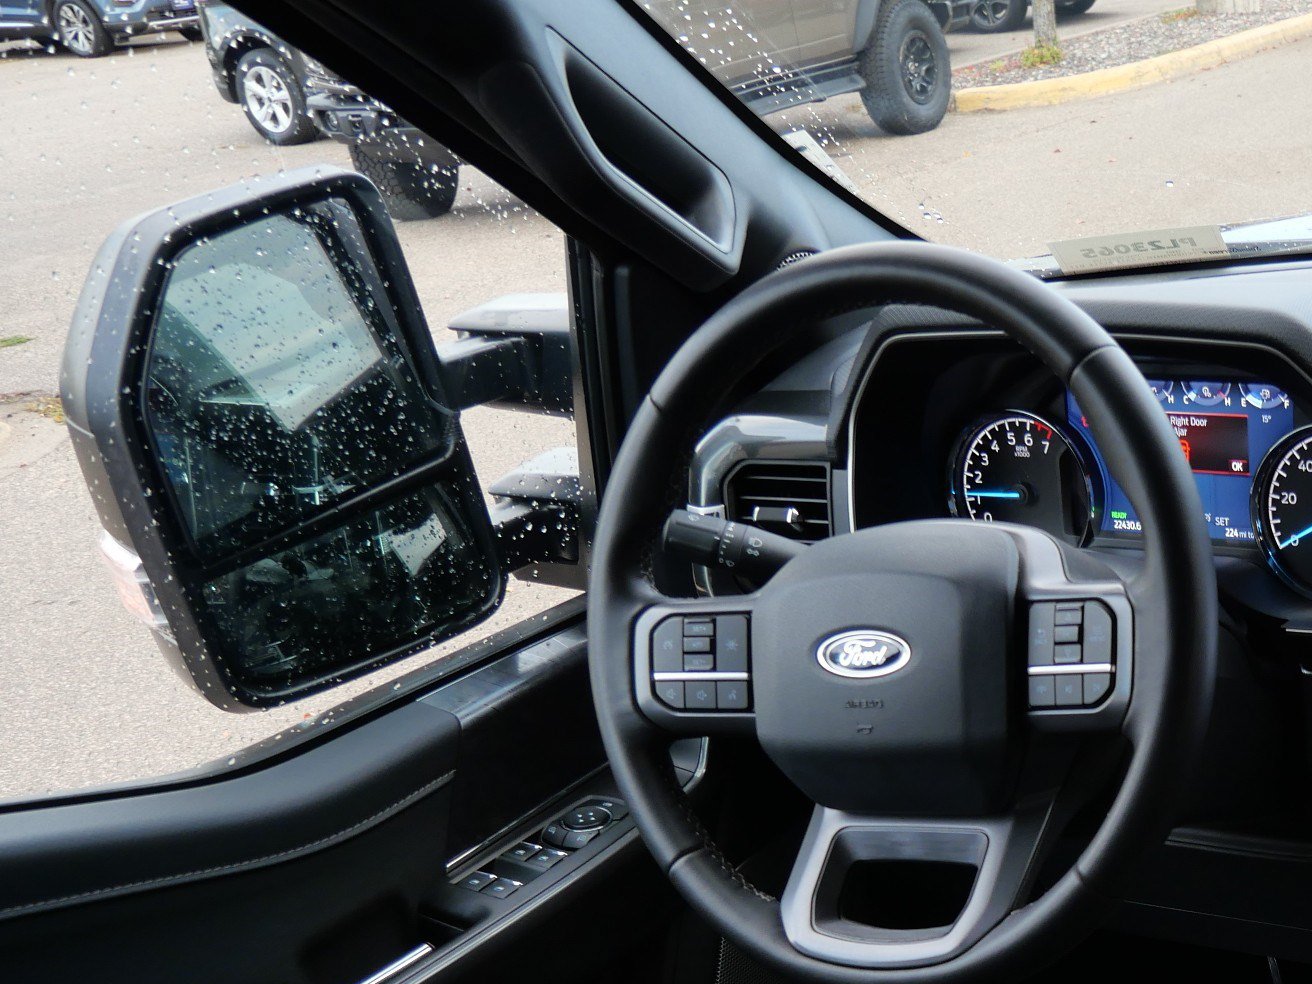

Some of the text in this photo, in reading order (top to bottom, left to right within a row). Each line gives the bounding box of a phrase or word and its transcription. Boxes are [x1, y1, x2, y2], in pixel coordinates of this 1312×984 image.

[1170, 416, 1207, 427] Right Door
[1007, 433, 1016, 446] 5
[1024, 433, 1033, 446] 6
[991, 440, 1000, 453] 4
[1041, 441, 1050, 455] 7
[981, 453, 989, 466] 3
[1231, 462, 1243, 472] OK
[974, 471, 983, 484] 2
[1281, 492, 1297, 505] 20
[1215, 517, 1230, 527] SET
[1225, 528, 1239, 539] 224
[839, 639, 888, 667] Ford
